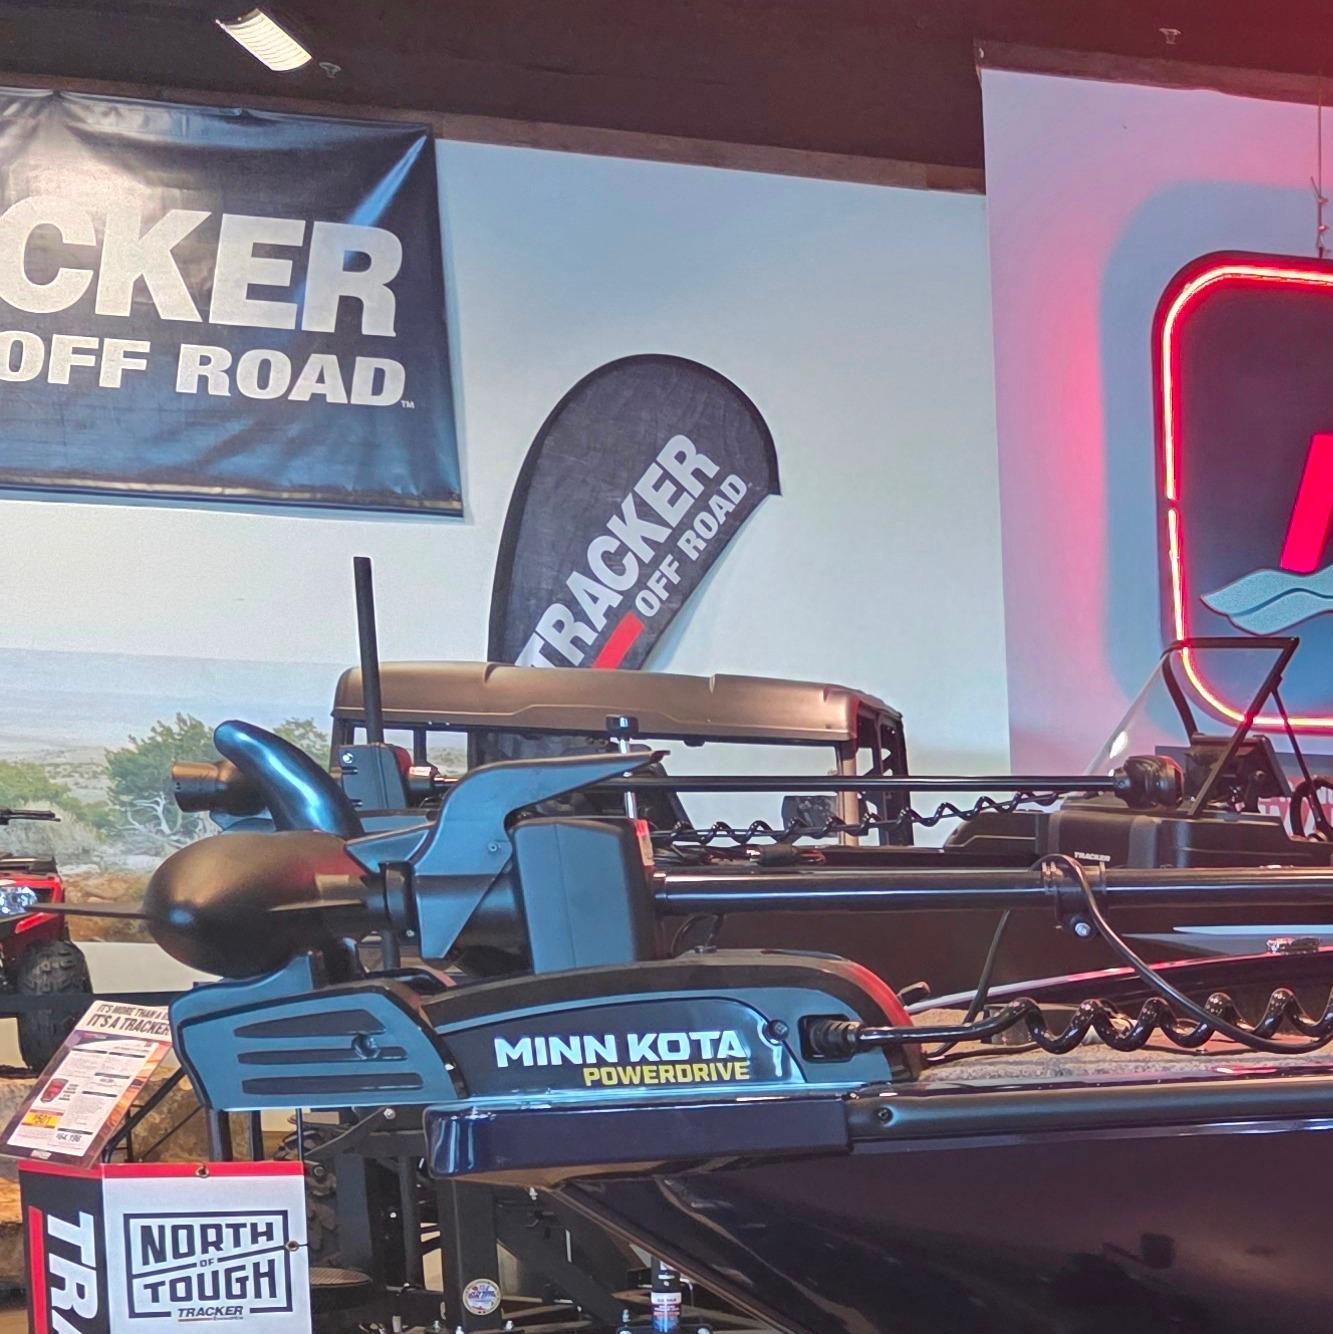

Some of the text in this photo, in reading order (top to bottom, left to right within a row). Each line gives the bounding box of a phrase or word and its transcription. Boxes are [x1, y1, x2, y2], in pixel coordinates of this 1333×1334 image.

[0, 330, 406, 406] OFF ROAD
[634, 473, 748, 617] OFF ROAD
[86, 1013, 113, 1028] IT'S
[494, 1030, 749, 1068] MINN KOTA
[583, 1061, 750, 1087] POWERDRIVE
[140, 1222, 274, 1266] NORTH
[199, 1258, 214, 1267] OF
[143, 1259, 277, 1303] TOUGH
[177, 1306, 243, 1318] TRACKER
